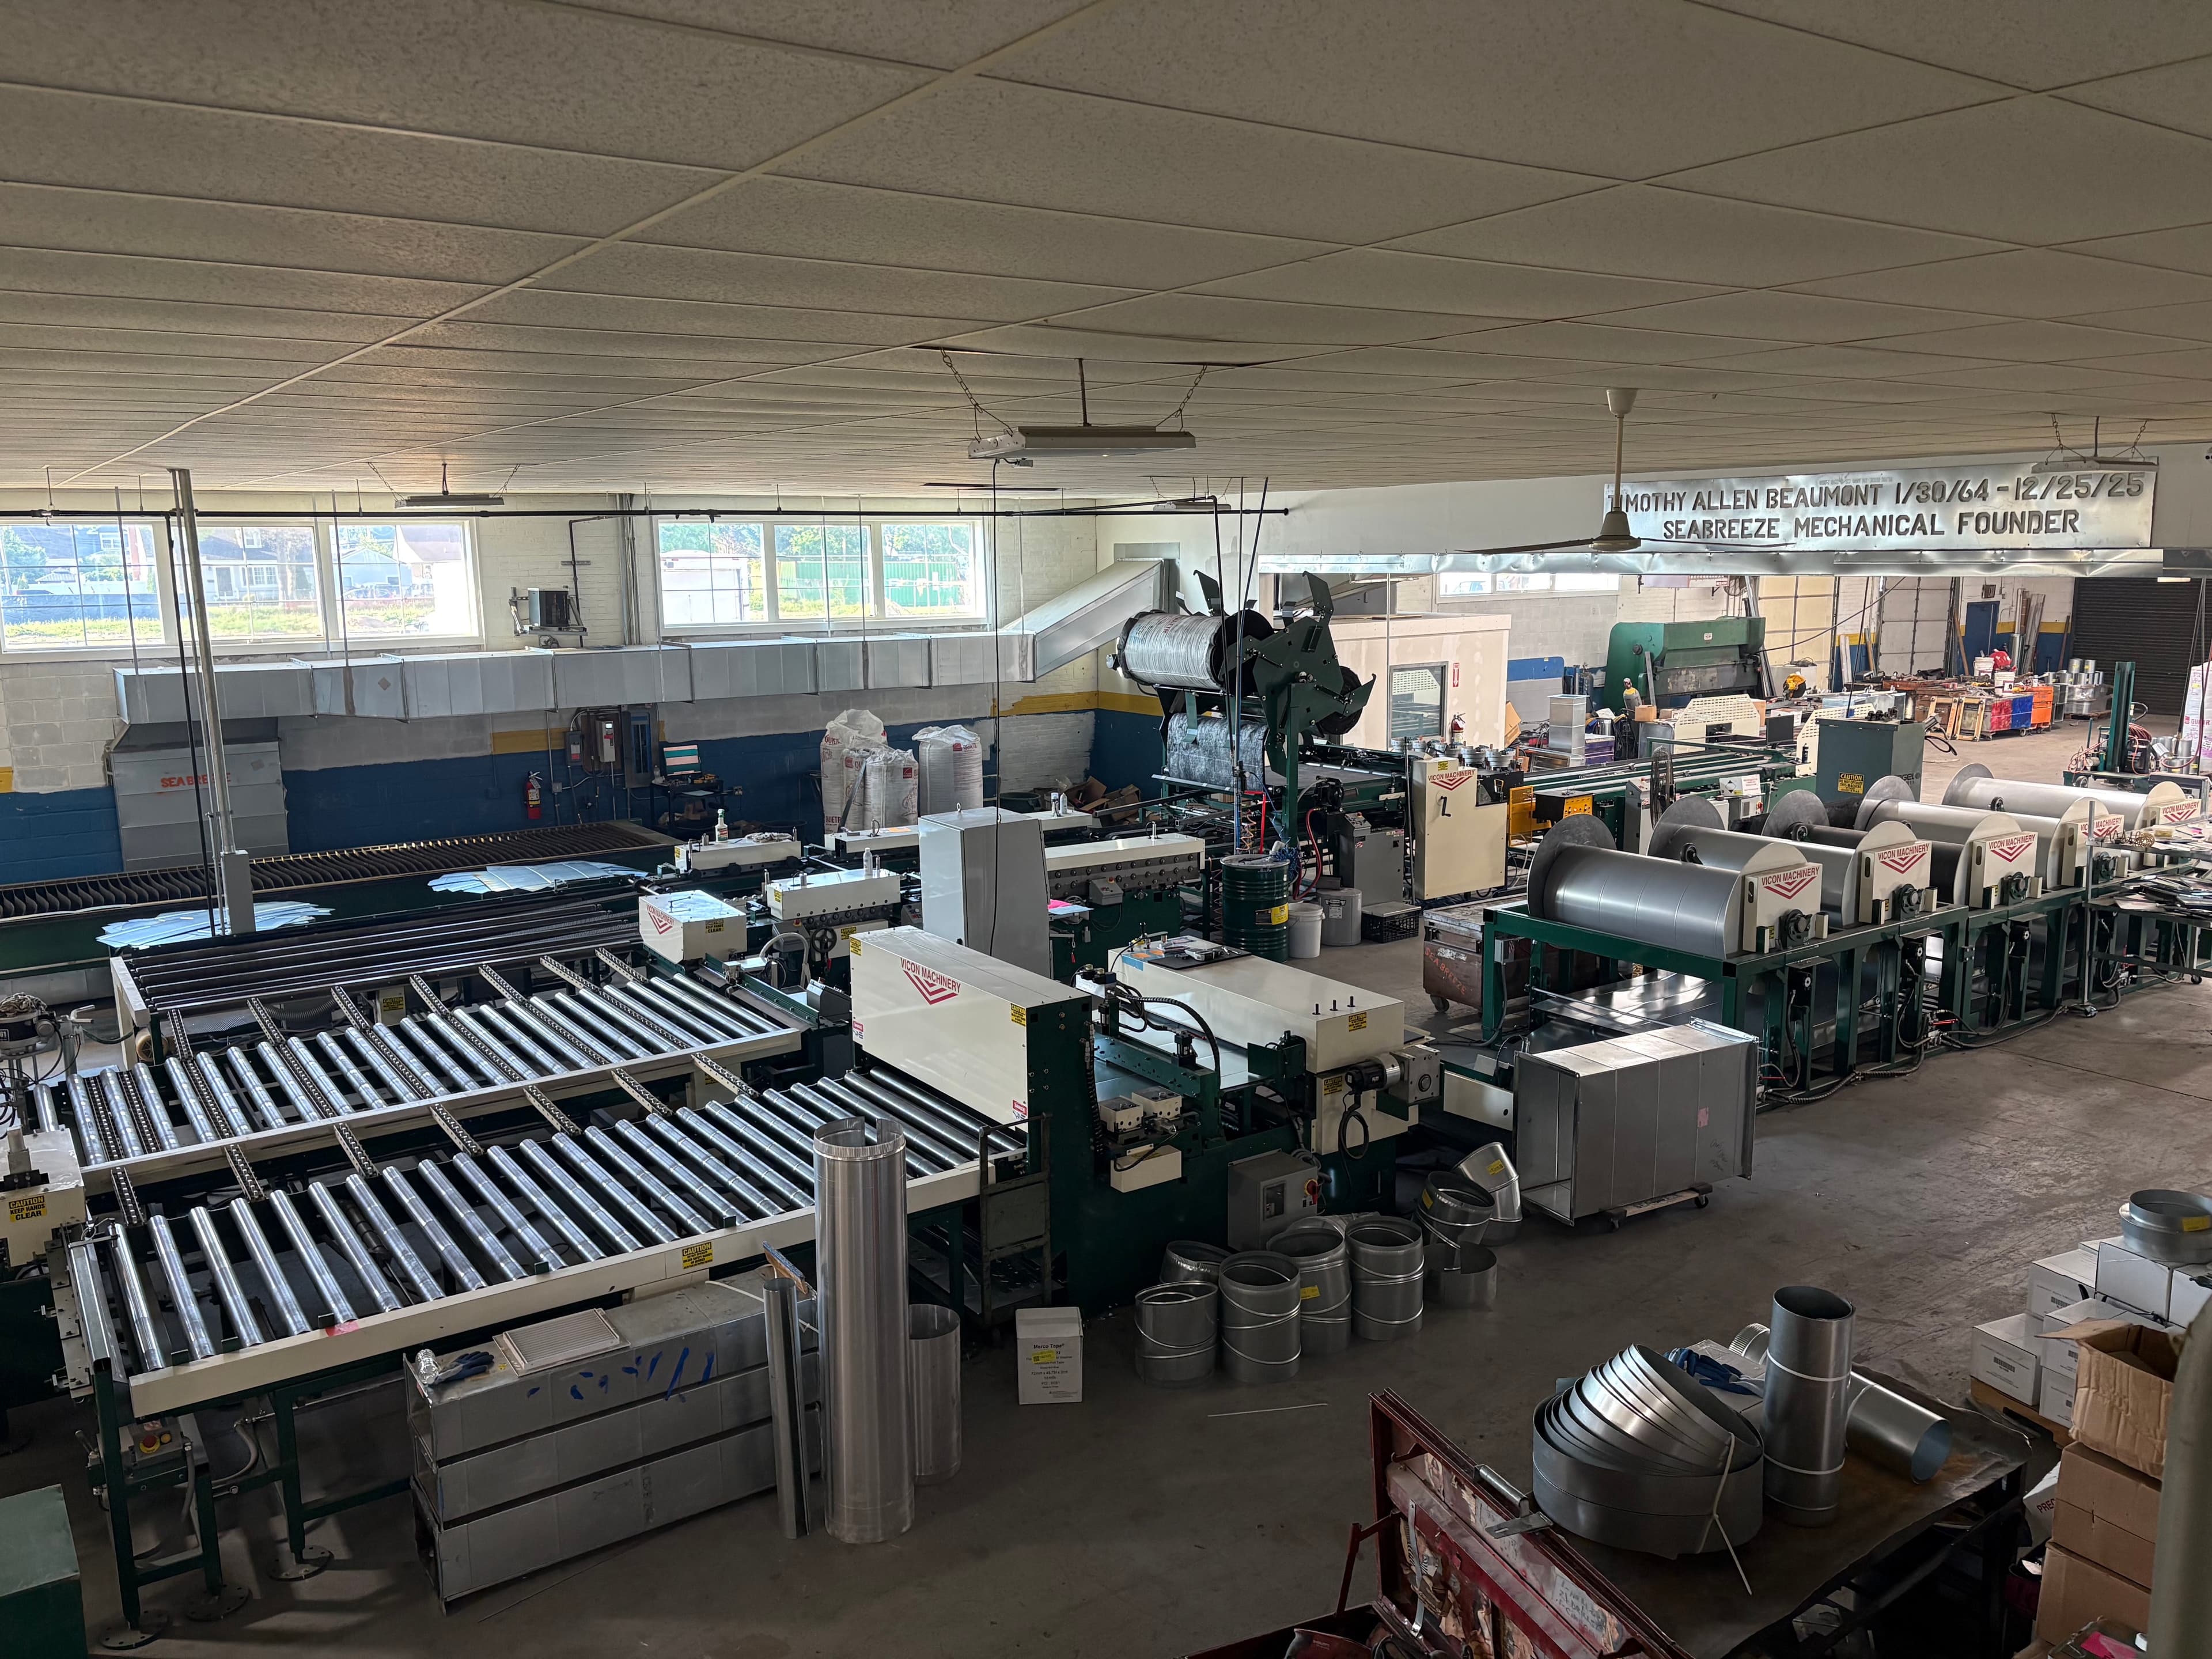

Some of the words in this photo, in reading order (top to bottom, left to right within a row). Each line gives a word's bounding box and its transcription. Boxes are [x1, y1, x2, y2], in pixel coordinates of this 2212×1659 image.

[1692, 488, 1759, 510] ALLEN
[1766, 484, 1883, 509] BEAUMONT
[1895, 478, 1989, 504] 1/30/64
[2014, 472, 2145, 501] 12/25/25
[1663, 518, 1781, 539] SEABREEZE
[1794, 513, 1945, 538] MECHANICAL
[1957, 509, 2080, 535] FOUNDER
[1445, 769, 1475, 779] MACHINERY
[2162, 805, 2175, 815] VICON
[2176, 801, 2199, 812] MACHINERY
[2096, 817, 2122, 828] MACHINERY
[1988, 840, 2005, 850] VICON
[2006, 834, 2036, 846] MACHINERY
[1878, 850, 1896, 861] VICON
[1897, 844, 1930, 857] MACHINERY
[1762, 874, 1781, 886] VICON
[1783, 866, 1820, 882] MACHINERY
[657, 907, 674, 927] MACHINERY
[900, 957, 920, 975] VICON
[922, 967, 961, 993] MACHINERY
[1349, 1013, 1366, 1021] CAUTION
[1325, 1077, 1342, 1085] CAUTION
[10, 1196, 44, 1208] CAUTION
[26, 1203, 46, 1212] HANDS
[16, 1210, 41, 1221] CLEAR
[683, 1243, 711, 1256] CAUTION
